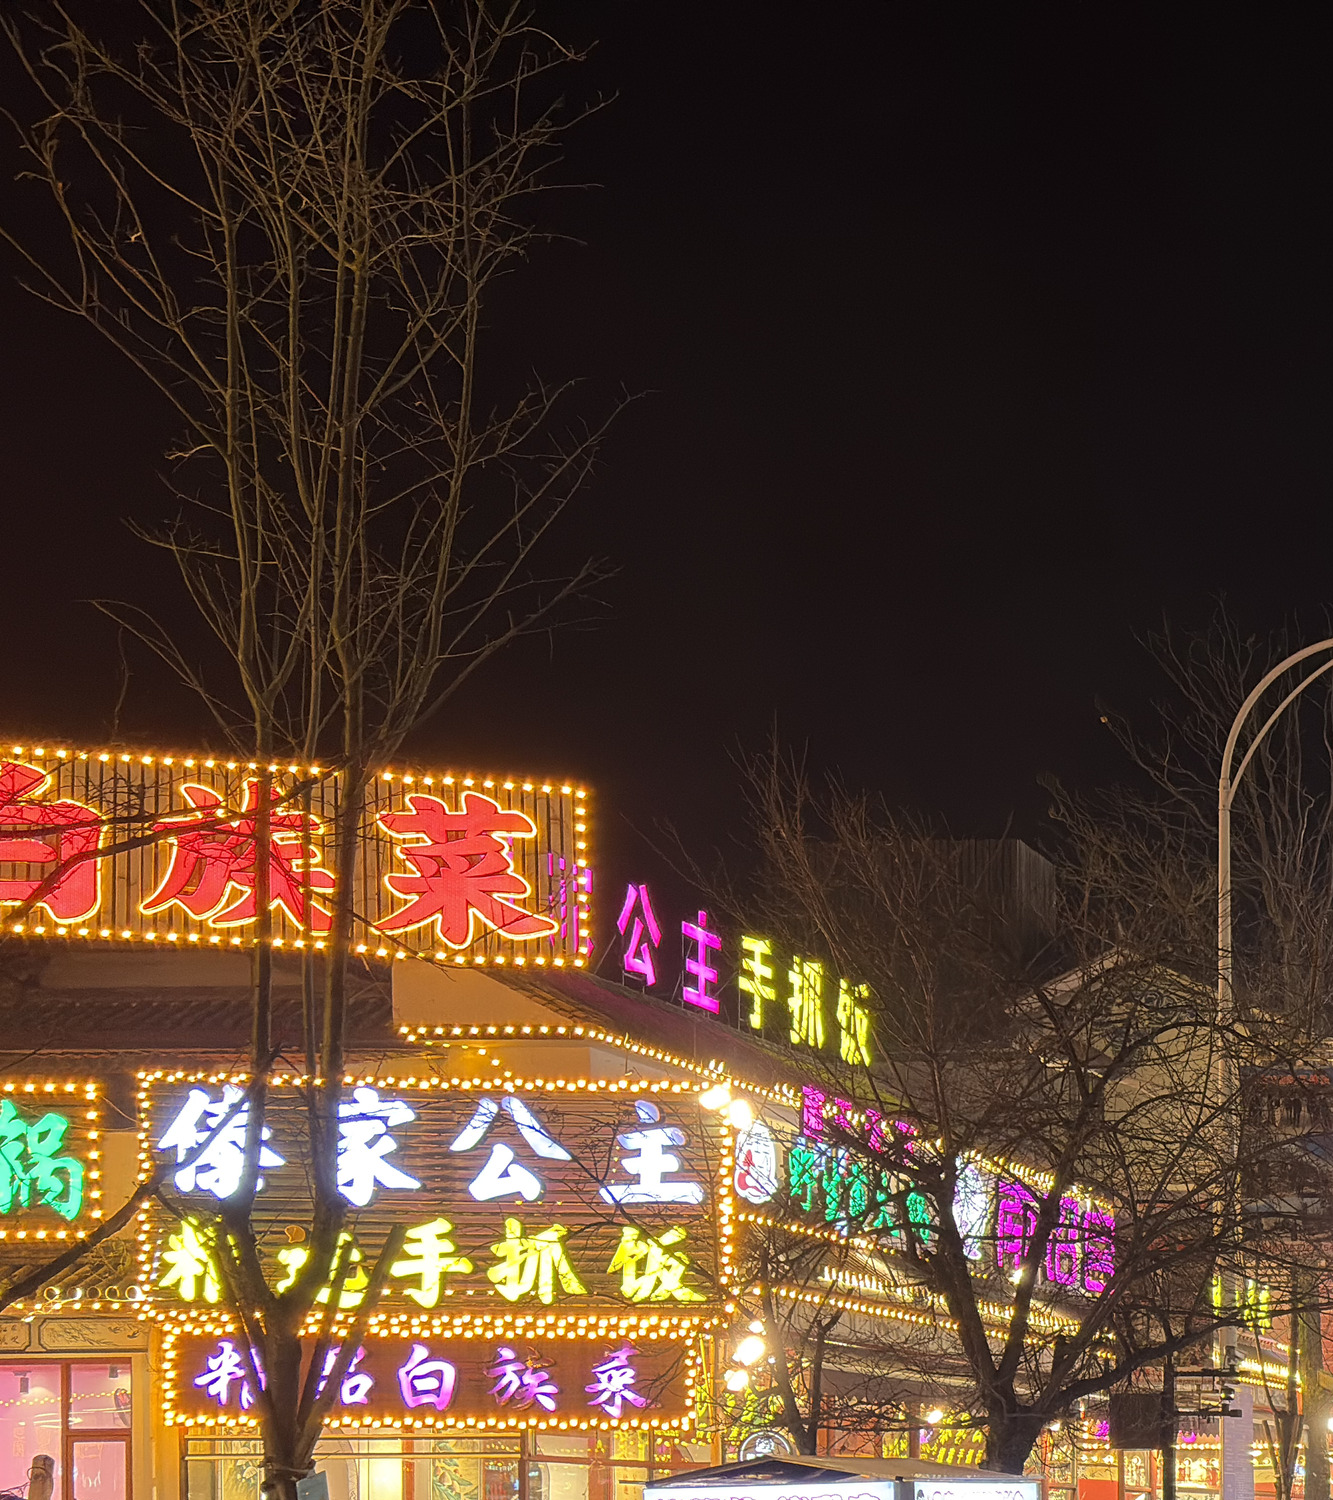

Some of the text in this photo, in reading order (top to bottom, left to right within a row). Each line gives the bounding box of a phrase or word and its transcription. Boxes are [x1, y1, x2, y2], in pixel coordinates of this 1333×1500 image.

[0, 760, 558, 947] 白族菜
[158, 1084, 703, 1207] 傣家公主
